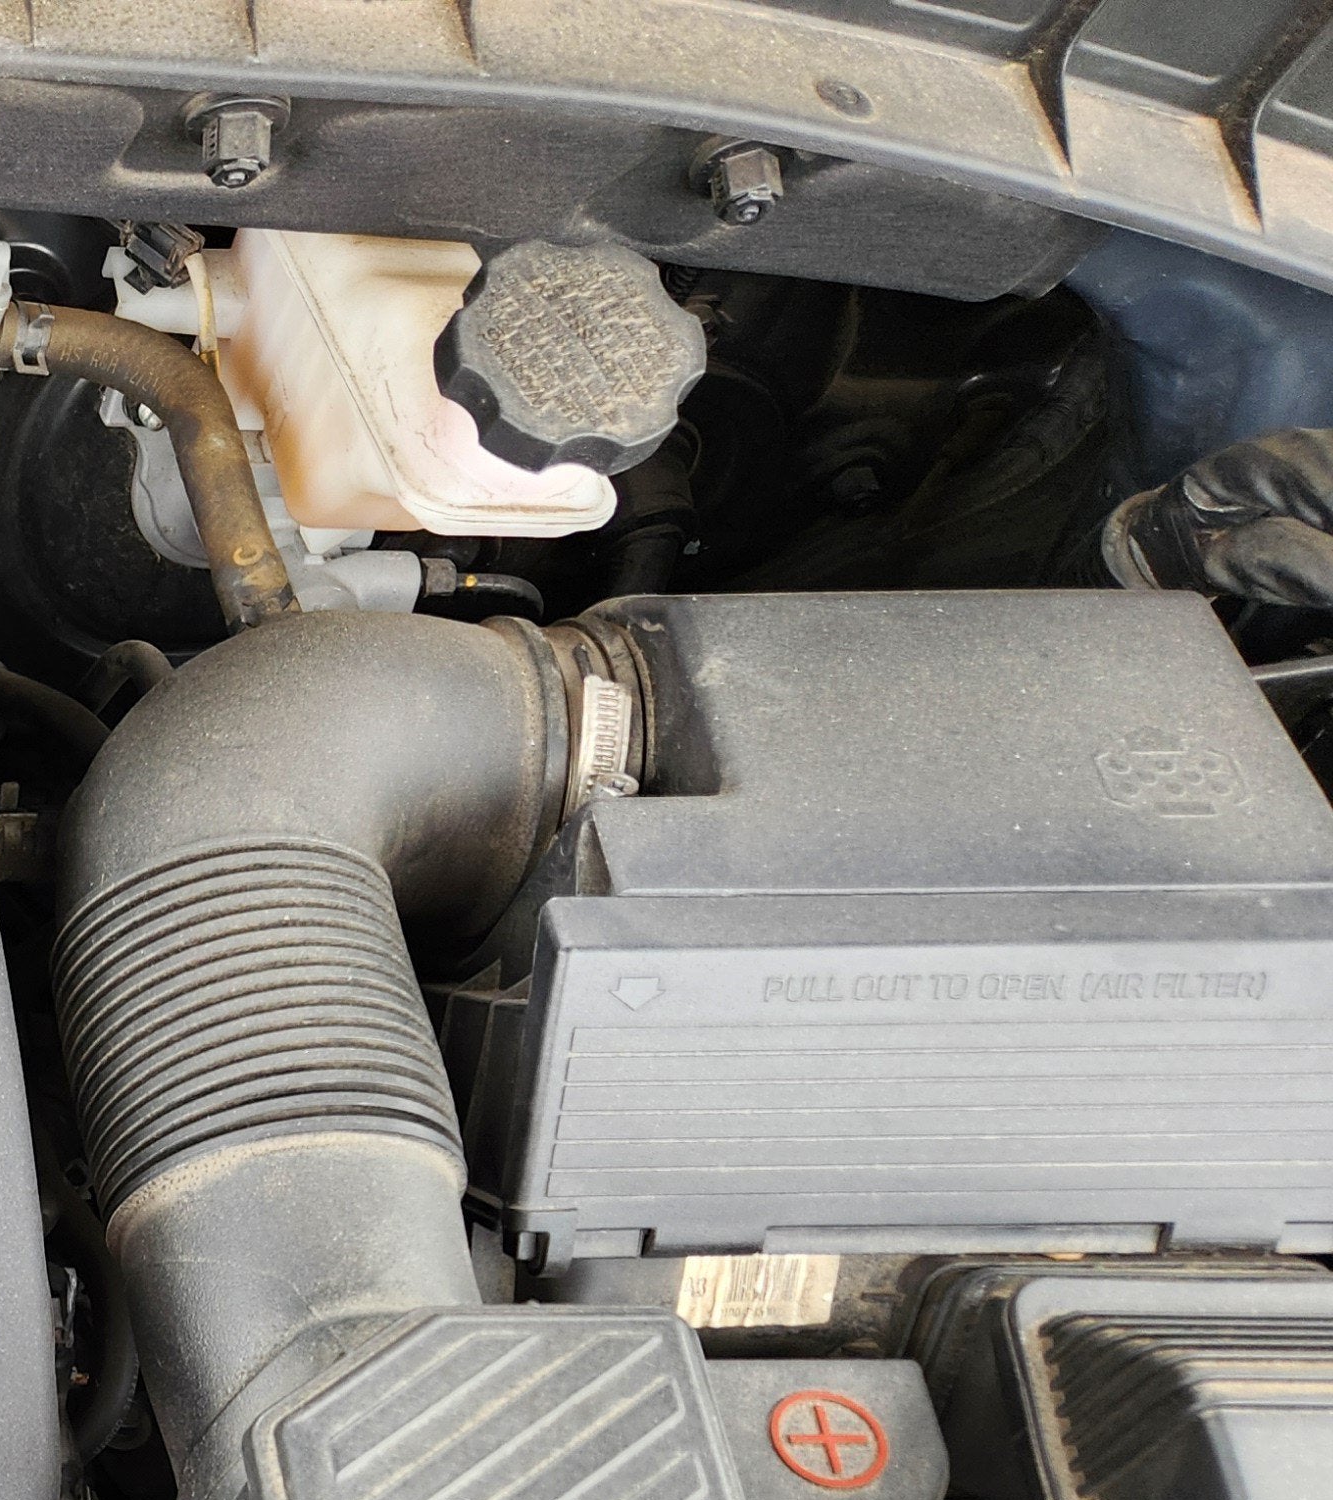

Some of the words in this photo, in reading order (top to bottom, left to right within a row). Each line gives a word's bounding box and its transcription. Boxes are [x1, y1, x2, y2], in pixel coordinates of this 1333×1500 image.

[763, 975, 843, 1003] PULL
[851, 974, 921, 1002] OUT
[929, 973, 970, 1001] TO
[977, 972, 1069, 1001] OPEN
[1079, 971, 1145, 1003] (AIR
[1152, 970, 1269, 1002] FILTER)
